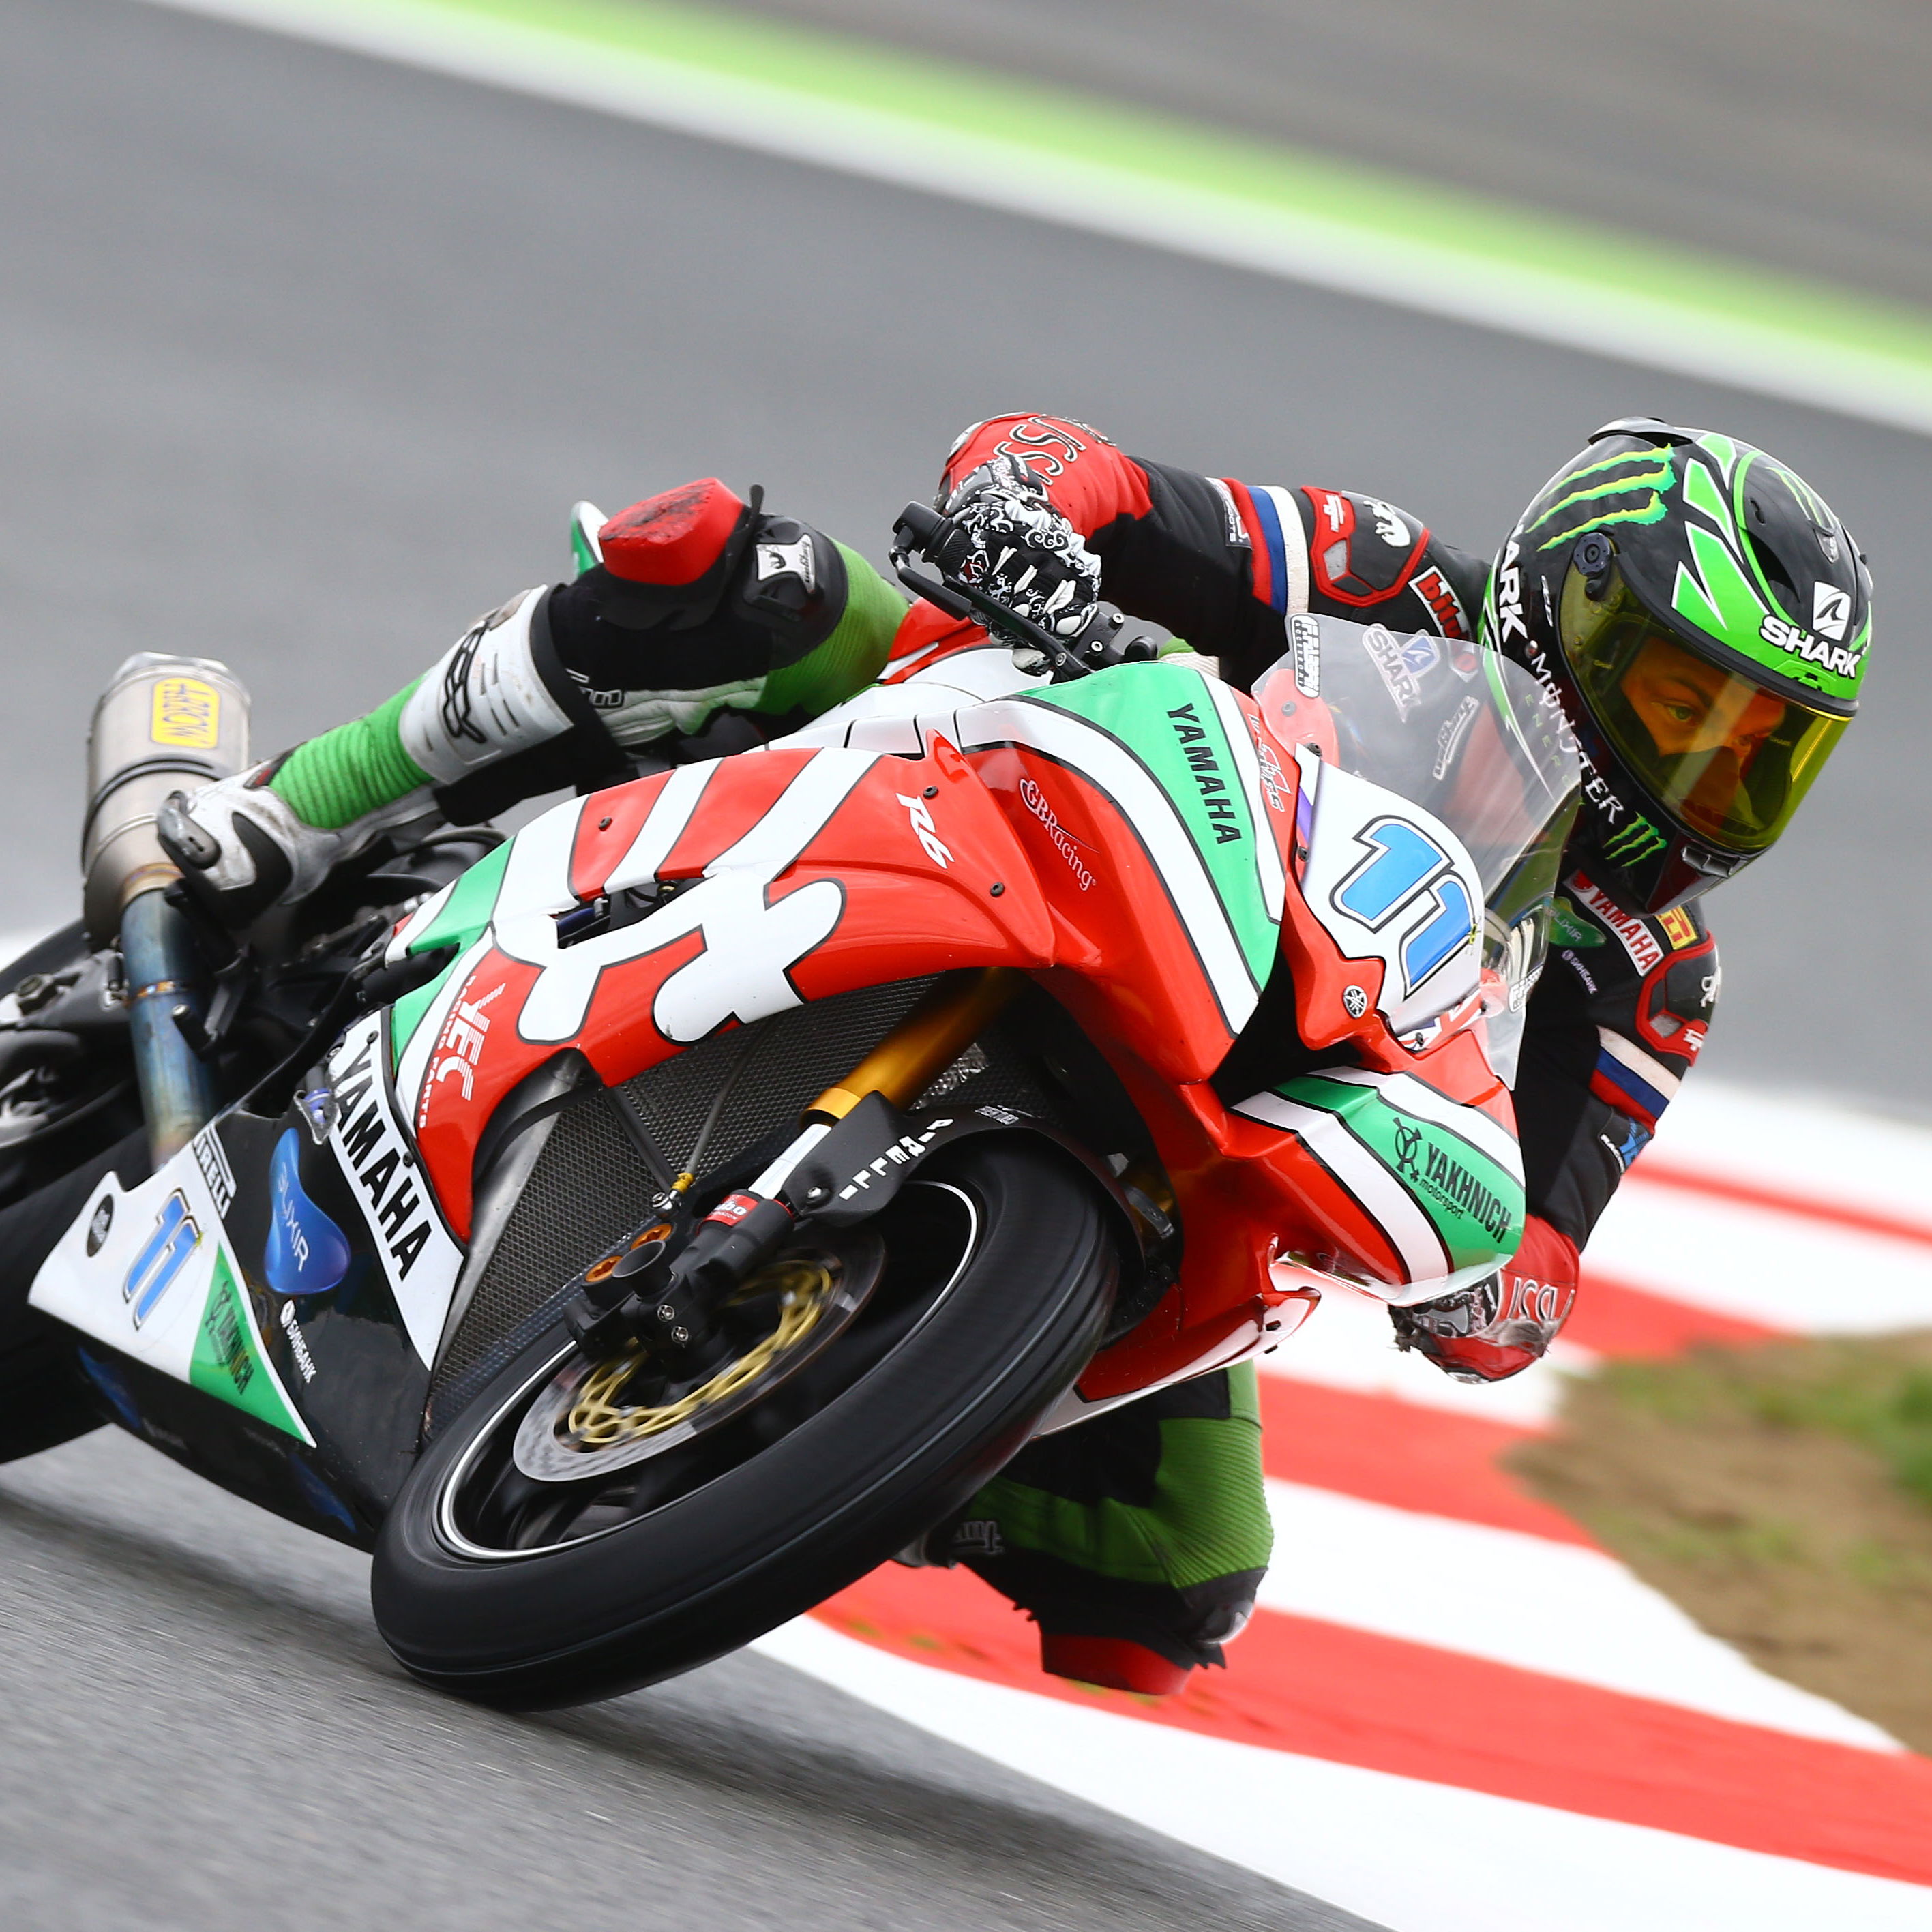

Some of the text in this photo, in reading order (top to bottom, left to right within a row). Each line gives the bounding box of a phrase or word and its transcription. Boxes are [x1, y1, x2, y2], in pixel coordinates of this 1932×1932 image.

[1367, 627, 1418, 709] SHARK
[1758, 614, 1862, 678] SHARK
[1167, 702, 1241, 845] YAMAHA
[895, 792, 955, 869] R6
[1329, 815, 1476, 1000] 11
[1588, 891, 1660, 970] YAMAHA
[436, 982, 506, 1101] YEC
[333, 1043, 432, 1282] YAMAHA
[839, 1118, 954, 1200] PIRELLI
[1419, 1178, 1464, 1219] motorsport
[1427, 1143, 1512, 1243] YAKHNICH
[288, 1320, 318, 1383] БИНБАНК
